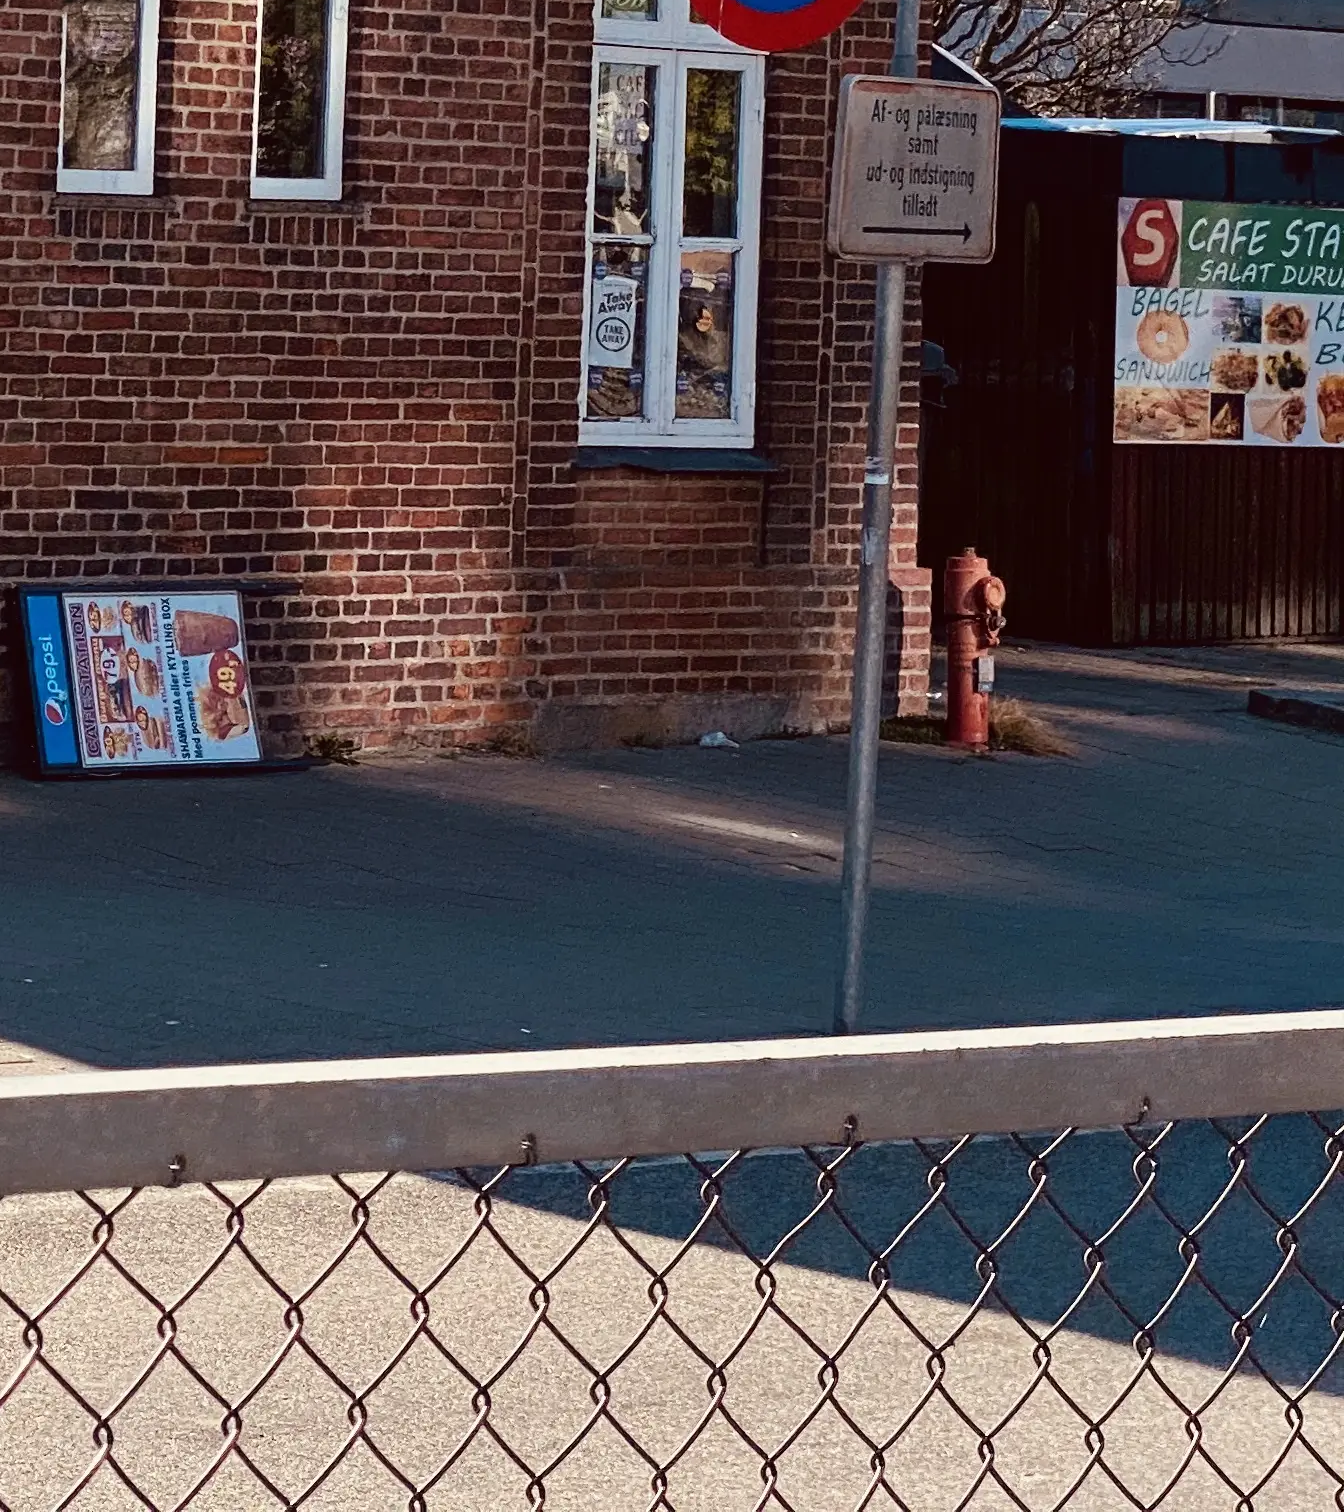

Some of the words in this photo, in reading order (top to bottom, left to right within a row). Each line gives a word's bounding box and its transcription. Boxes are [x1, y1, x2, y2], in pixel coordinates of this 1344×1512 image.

[896, 109, 910, 132] og
[917, 104, 977, 136] pålæsning
[908, 135, 939, 156] samt
[909, 163, 975, 193] indstigning
[902, 194, 938, 217] tilladt
[1188, 217, 1271, 257] CAFE
[1281, 218, 1344, 259] STA
[1198, 259, 1277, 283] SALAT
[1280, 265, 1344, 289] DURU
[597, 300, 633, 315] Away
[603, 291, 633, 304] Take
[1131, 288, 1210, 318] BAGEL
[601, 334, 625, 345] AWAY
[604, 324, 624, 334] TAKE
[1115, 358, 1213, 384] SANDWICH
[160, 597, 171, 620] BOX
[162, 623, 178, 671] KYLLING
[39, 635, 66, 696] pepsi
[181, 659, 195, 688] frites
[168, 673, 181, 699] eller
[187, 690, 201, 735] pommes
[171, 699, 191, 760] SHAWARMA
[191, 737, 204, 759] Med
